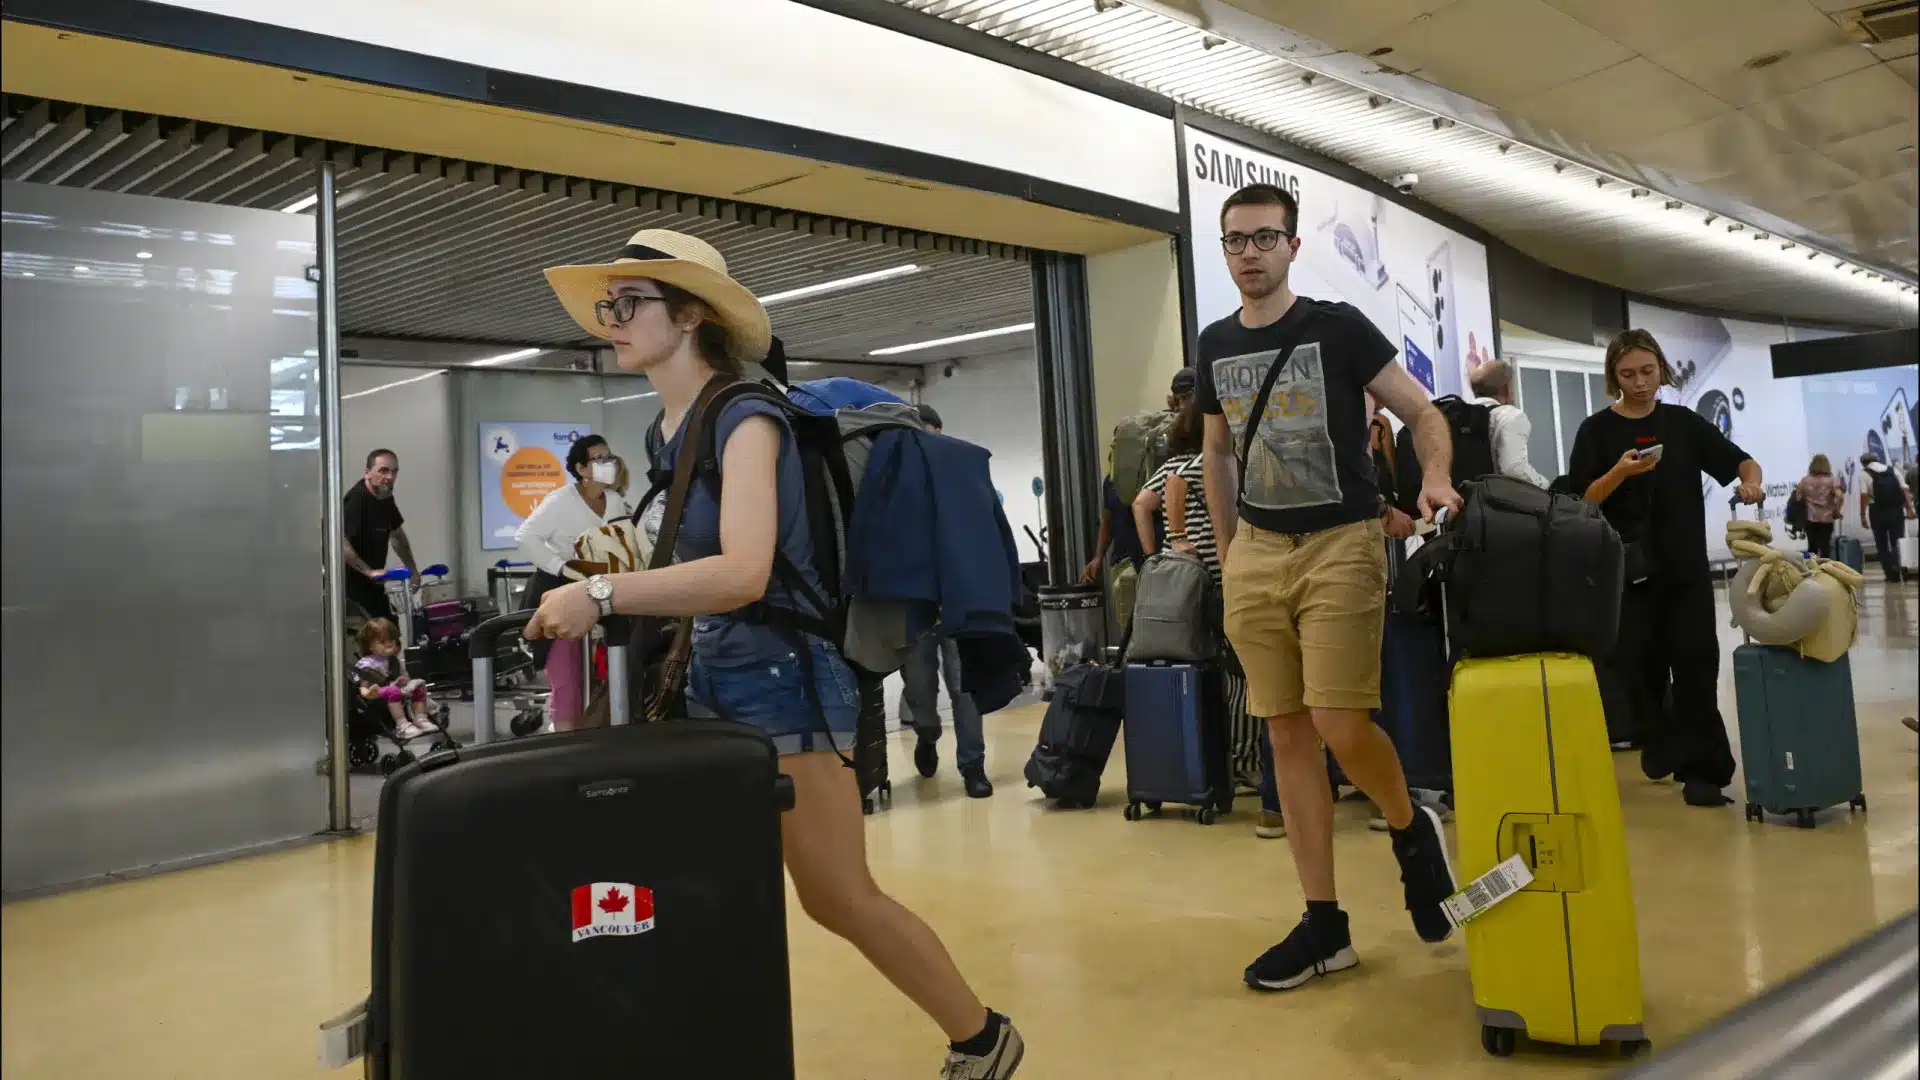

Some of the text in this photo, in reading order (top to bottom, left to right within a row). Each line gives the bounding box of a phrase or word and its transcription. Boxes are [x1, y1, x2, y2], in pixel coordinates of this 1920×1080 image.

[1194, 143, 1300, 206] SAMSUNG
[585, 786, 629, 798] Samsonite
[576, 921, 651, 939] VANCOUVER
